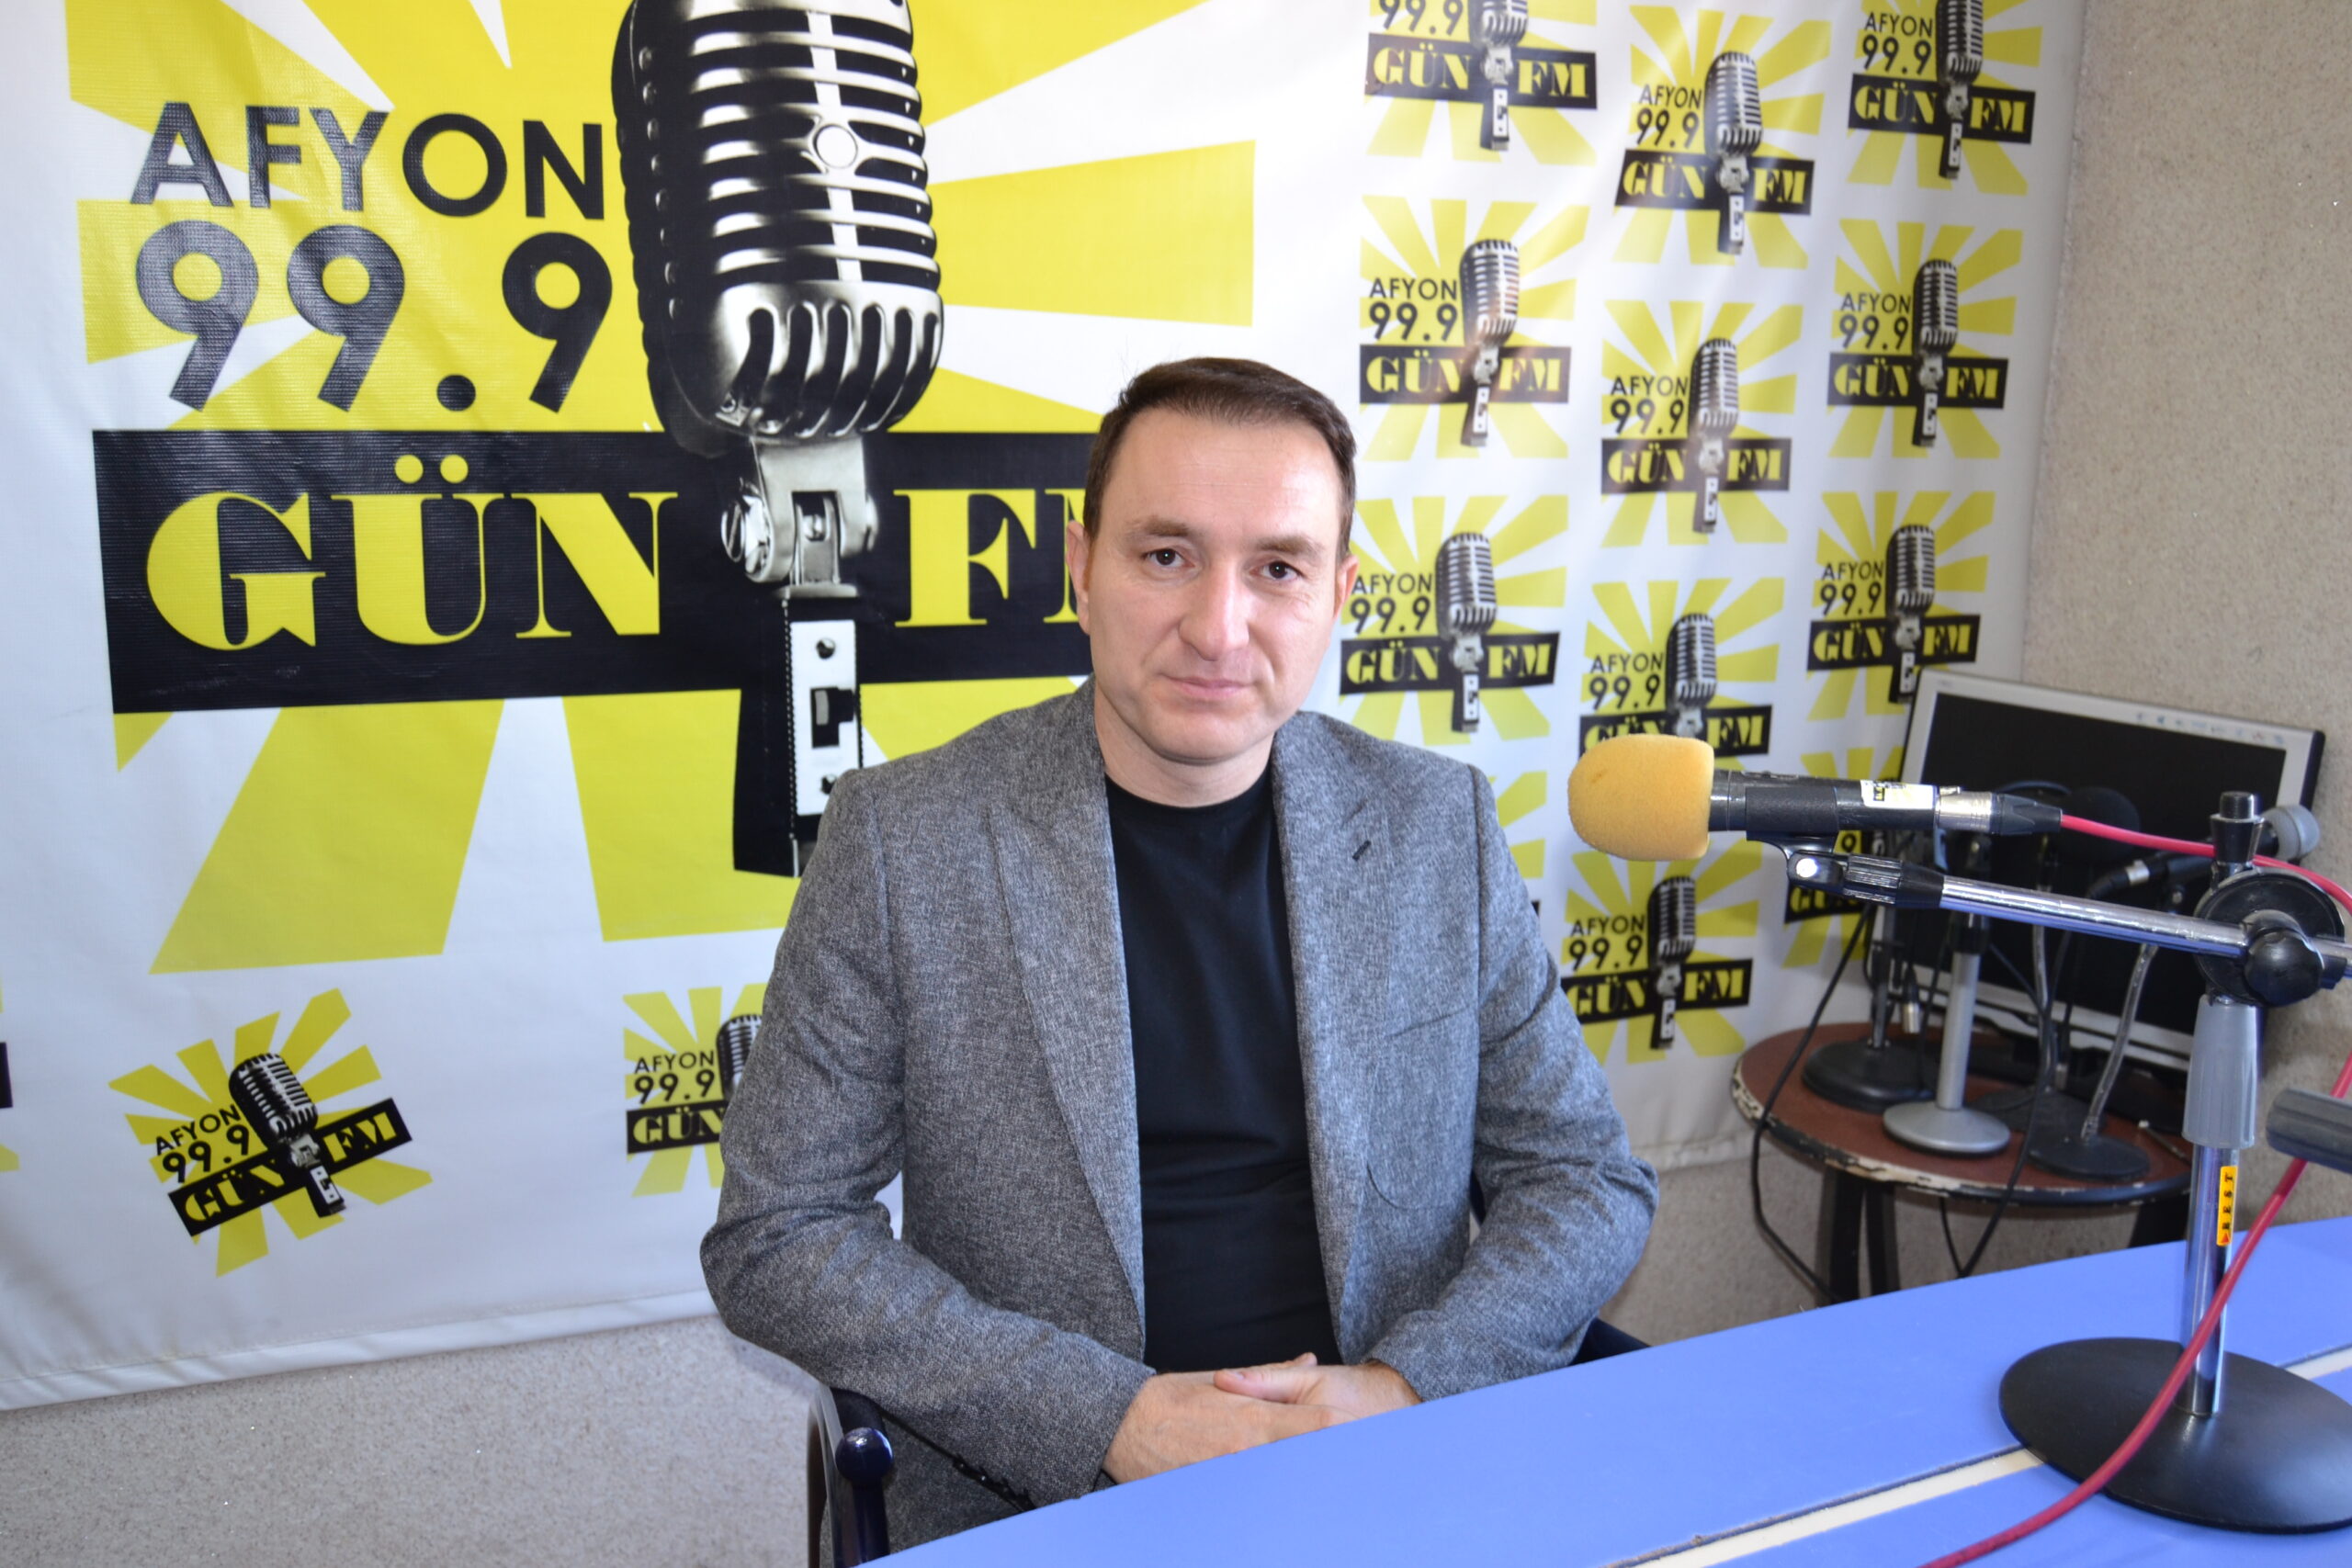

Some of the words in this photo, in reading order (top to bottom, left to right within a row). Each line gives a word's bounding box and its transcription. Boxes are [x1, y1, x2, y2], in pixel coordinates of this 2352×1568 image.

[1864, 11, 1933, 38] AFYON
[1374, 42, 1471, 90] GÜN
[1516, 60, 1589, 98] FM
[1862, 35, 1932, 74] 99.9
[1638, 84, 1703, 110] AFYON
[1854, 81, 1937, 125] GÜN
[1970, 97, 2027, 133] FM
[1635, 107, 1700, 149] 99.9
[130, 101, 605, 221] AFYON
[1623, 155, 1708, 199] GÜN
[1754, 167, 1807, 205] FM
[1369, 276, 1458, 301] AFYON
[1840, 292, 1912, 314] AFYON
[135, 220, 613, 413] 99.9
[1369, 301, 1458, 342] 99.9
[1839, 314, 1909, 350] 99.9
[1366, 349, 1463, 393] GÜN
[1498, 357, 1562, 391] FM
[1610, 376, 1689, 397] AFYON
[1834, 359, 1912, 398] GÜN
[1945, 368, 2000, 400] FM
[1610, 398, 1684, 435] 99.9
[1607, 443, 1688, 484] GÜN
[1726, 449, 1783, 482] FM
[146, 453, 679, 651] GÜN
[893, 489, 1087, 627] F
[1821, 560, 1883, 581] AFYON
[1351, 573, 1432, 594] AFYON
[1820, 582, 1882, 615] 99.9
[1350, 595, 1430, 634] 99.9
[1814, 621, 1885, 661] GÜN
[1922, 625, 1974, 656] FM
[1345, 640, 1441, 684] GÜN
[1487, 643, 1551, 679] FM
[1589, 652, 1664, 674] AFYON
[1589, 674, 1661, 710] 99.9
[1706, 716, 1764, 749] FM
[1570, 915, 1645, 937] AFYON
[1569, 935, 1644, 972] 99.9
[1566, 976, 1649, 1015] GÜN
[1683, 968, 1745, 1002] FM
[634, 1050, 715, 1075] AFYON
[634, 1069, 715, 1104] 99.9
[155, 1104, 242, 1156] AFYON
[632, 1106, 726, 1145] GÜN
[162, 1124, 249, 1184] 99.9
[185, 1157, 286, 1222] GÜN
[322, 1111, 397, 1164] FM
